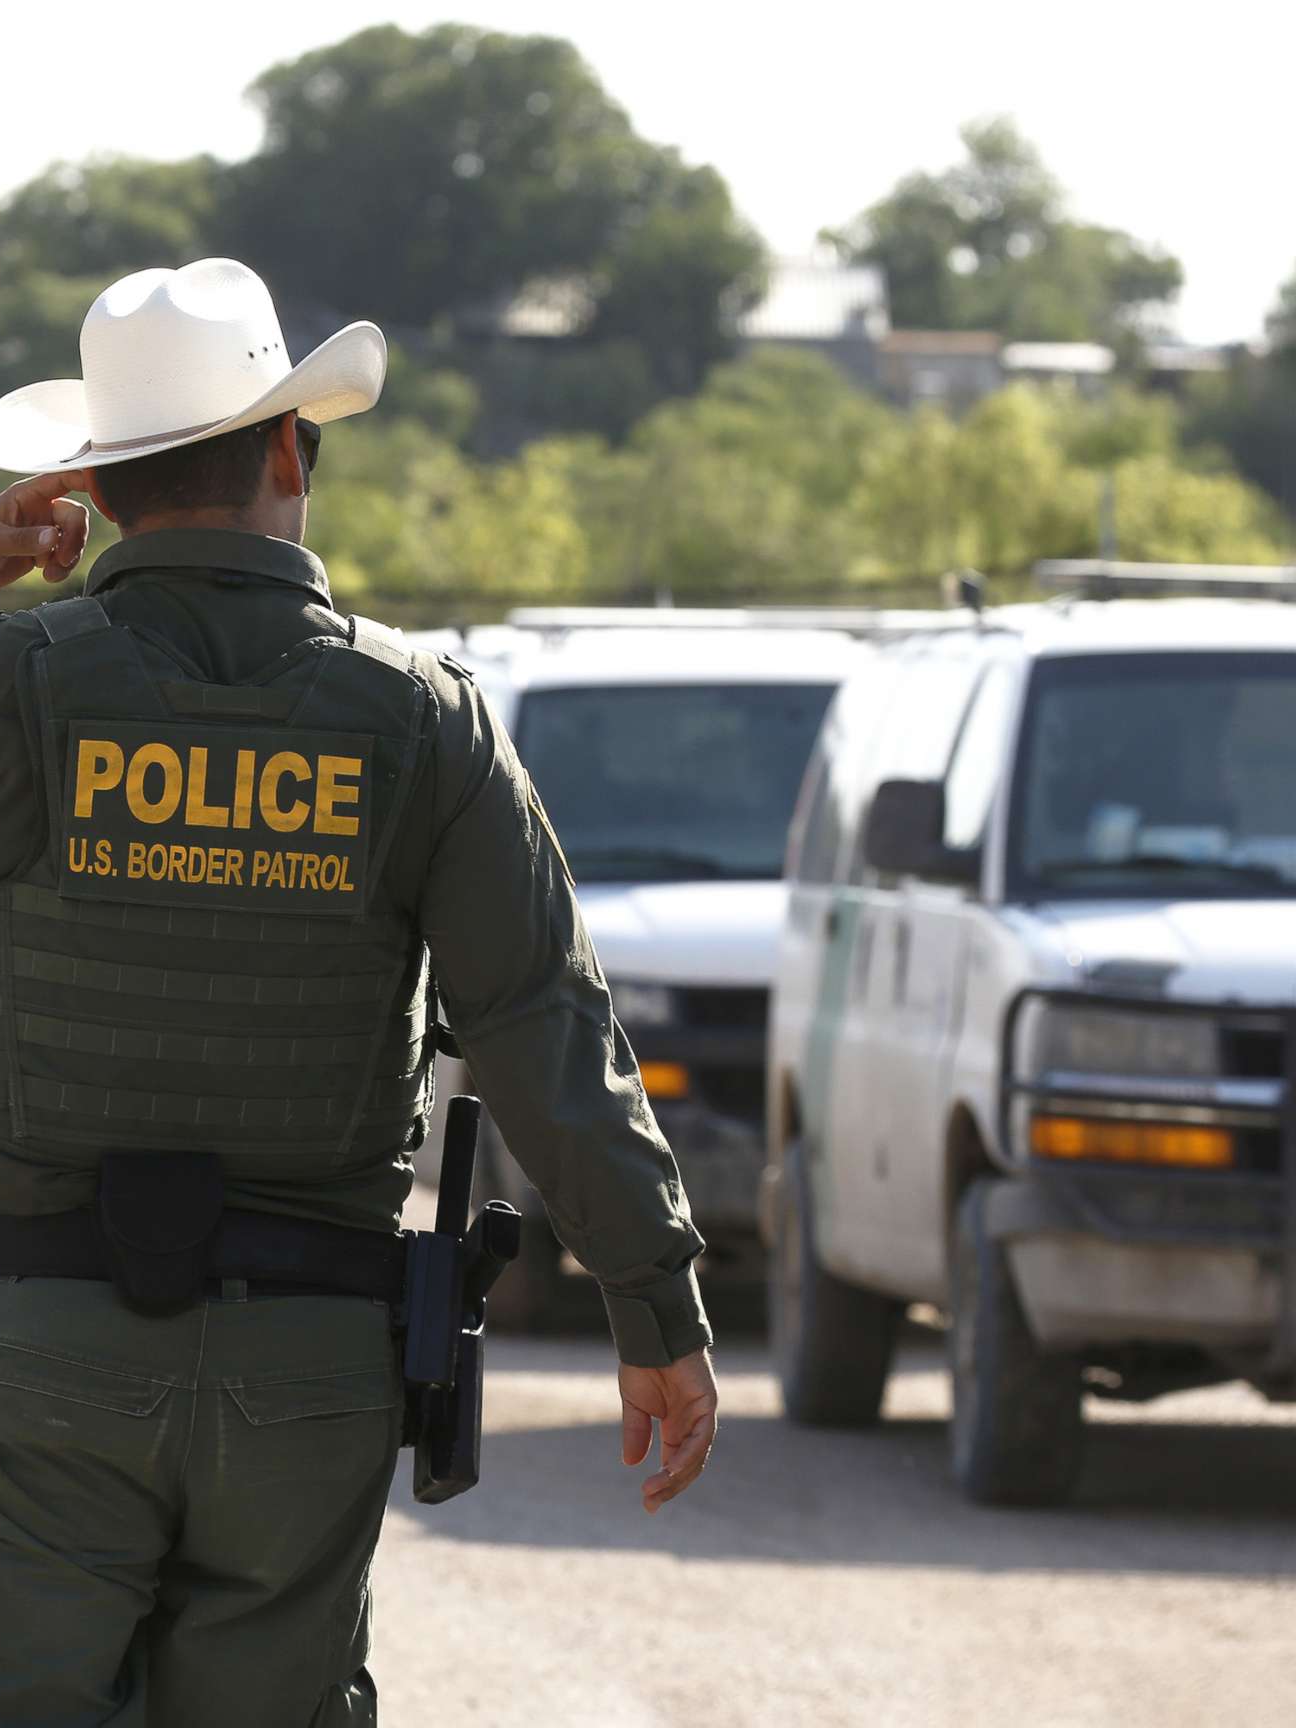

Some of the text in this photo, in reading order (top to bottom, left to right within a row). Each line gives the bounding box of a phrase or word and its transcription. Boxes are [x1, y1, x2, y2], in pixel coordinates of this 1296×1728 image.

[73, 738, 363, 837] POLICE
[68, 836, 355, 892] U.S. BORDER PATROL
